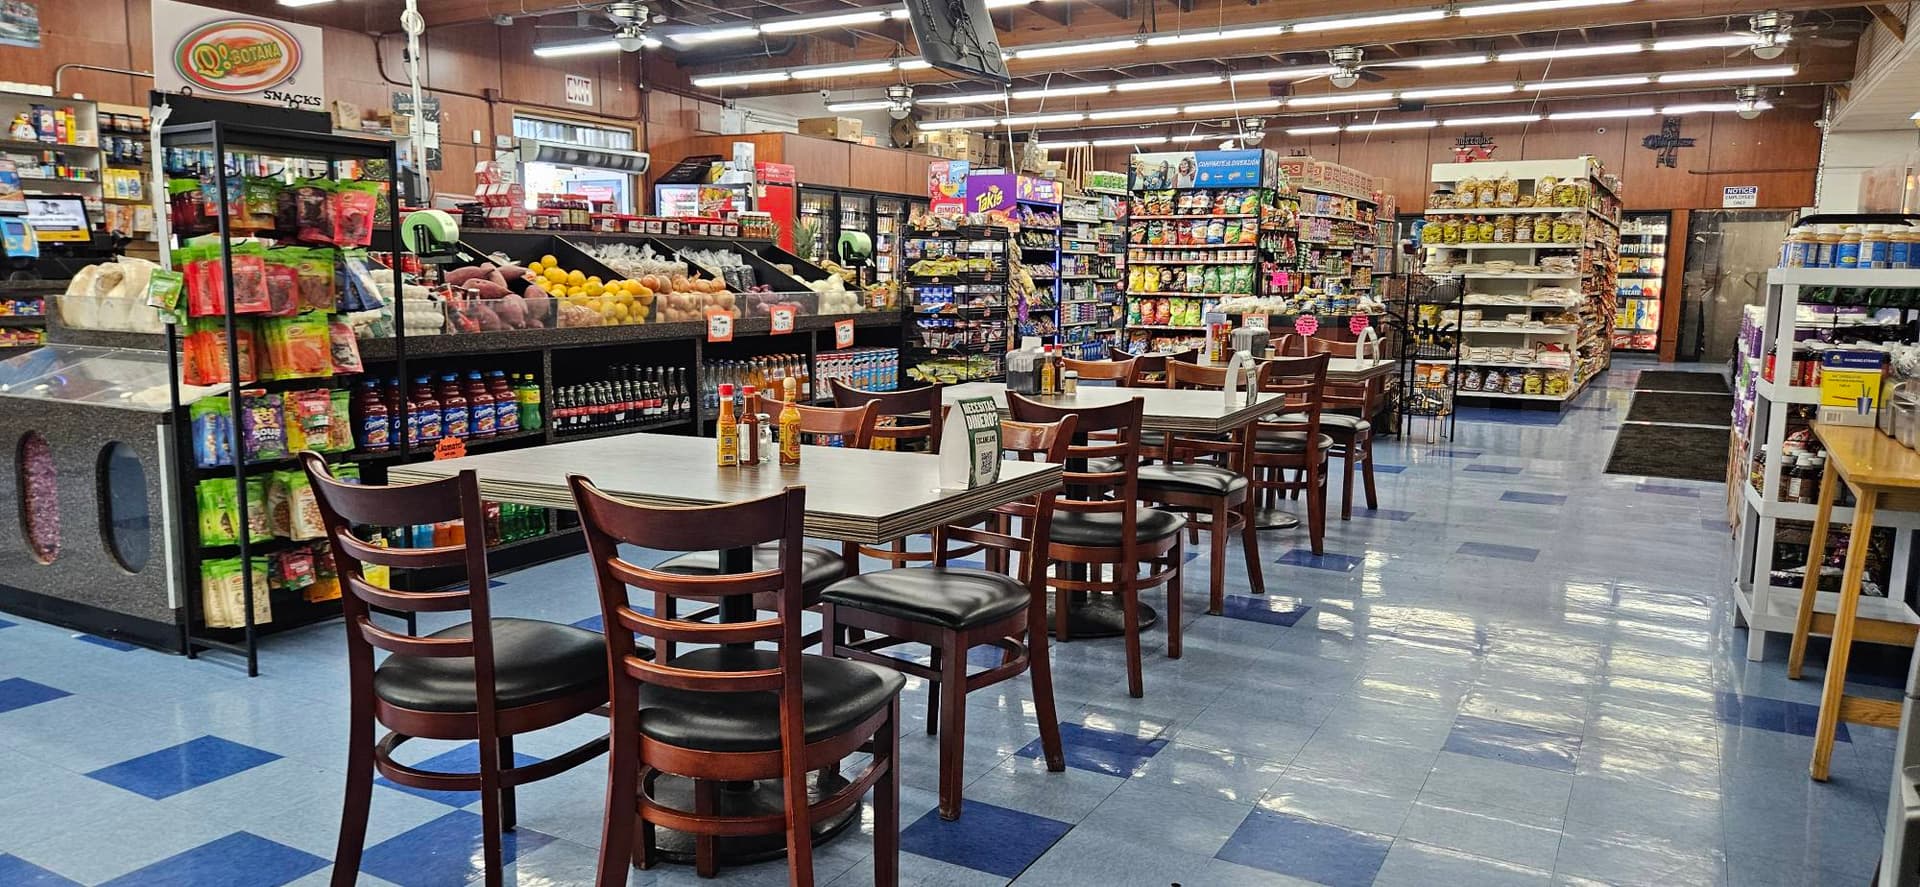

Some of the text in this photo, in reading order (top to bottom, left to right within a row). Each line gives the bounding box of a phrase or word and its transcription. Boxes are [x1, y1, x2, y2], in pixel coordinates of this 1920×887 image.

[264, 90, 321, 106] SNACKS
[567, 77, 590, 102] EXIT
[976, 189, 1003, 212] Takis
[961, 400, 996, 414] NECESITAS
[965, 412, 998, 430] DINERO?
[252, 428, 280, 439] SOUR
